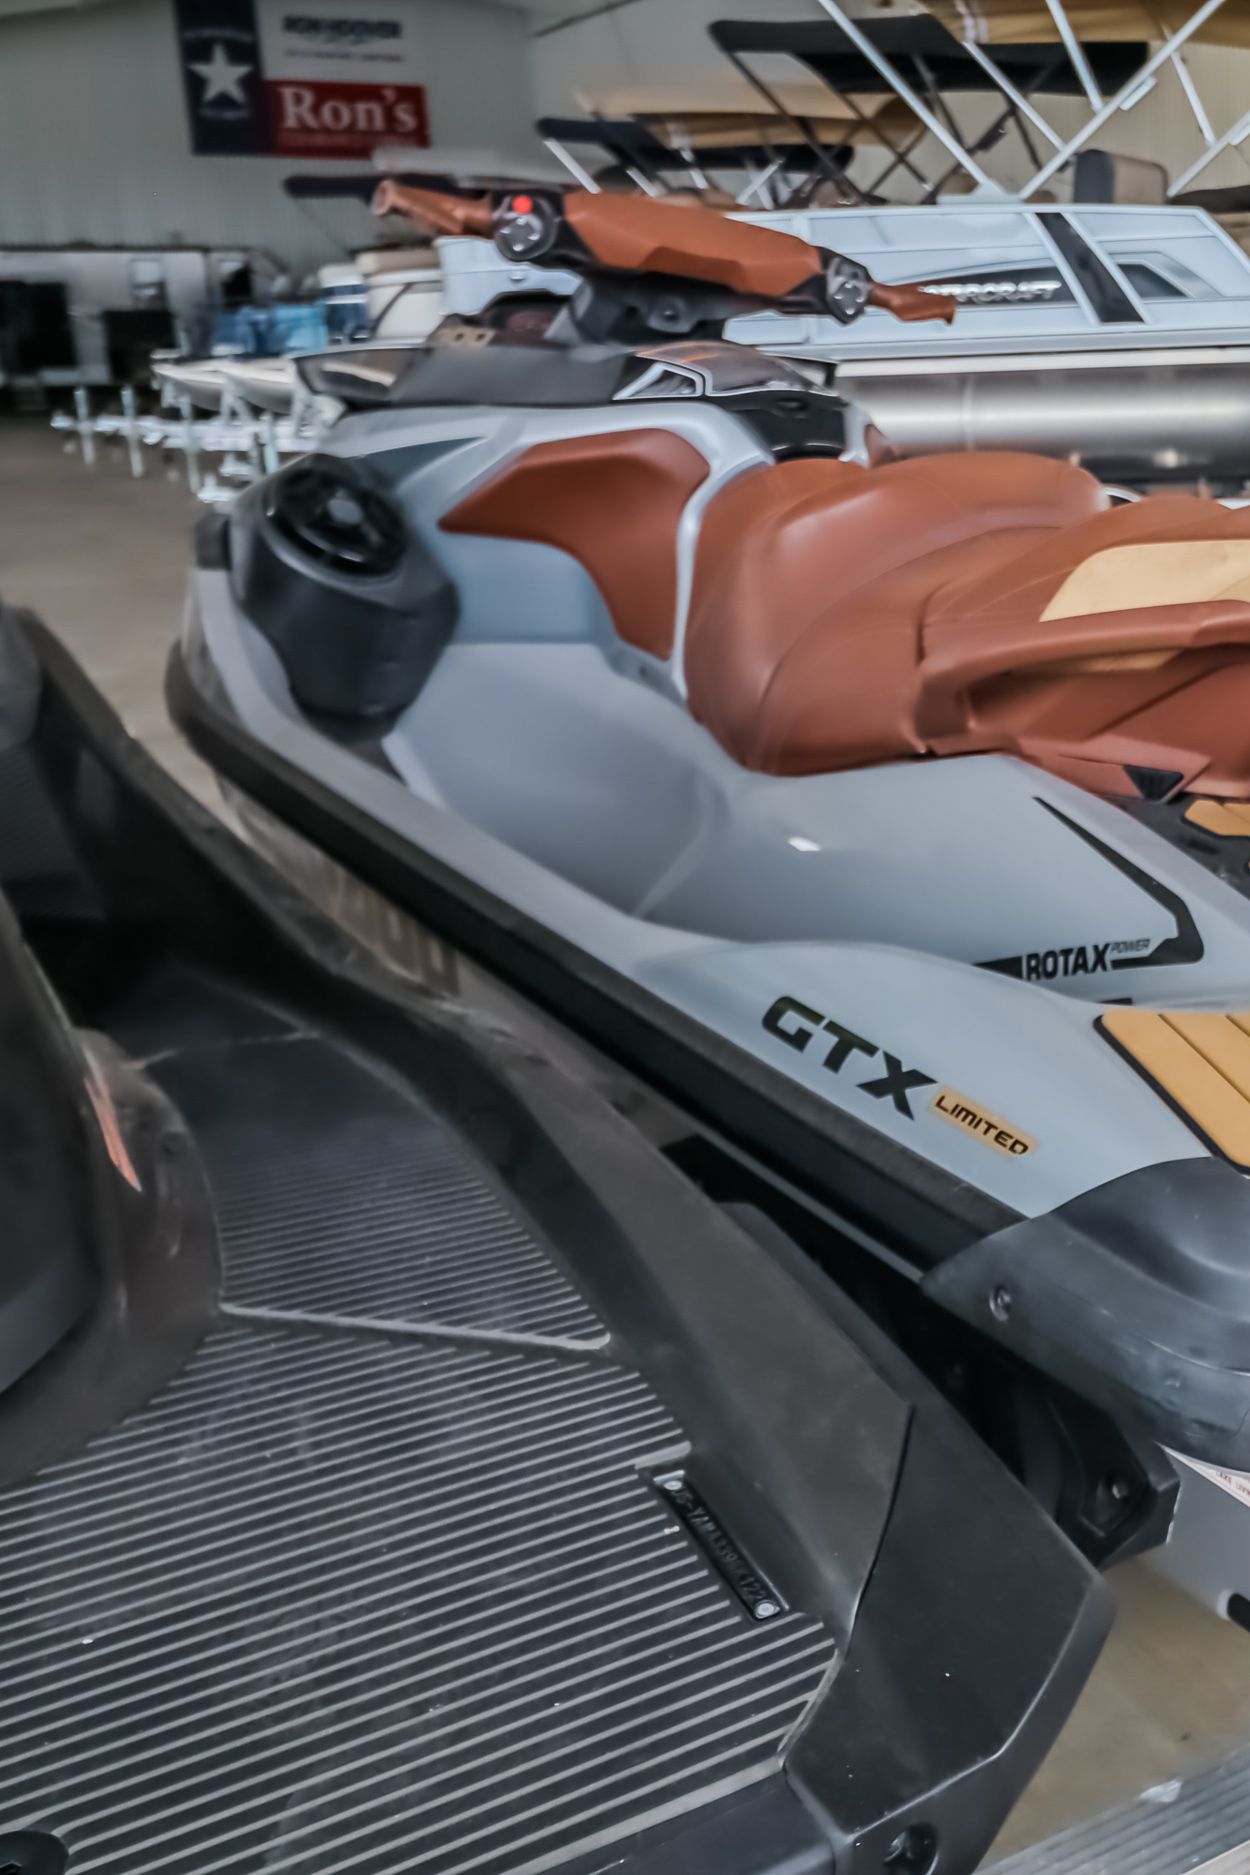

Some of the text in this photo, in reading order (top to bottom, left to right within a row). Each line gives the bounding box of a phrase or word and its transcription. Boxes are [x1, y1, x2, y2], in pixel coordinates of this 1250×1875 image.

[278, 86, 418, 132] Ron's
[1025, 943, 1111, 982] ROTAX
[1110, 939, 1151, 954] POWER
[762, 996, 1029, 1155] GTX LIMITED
